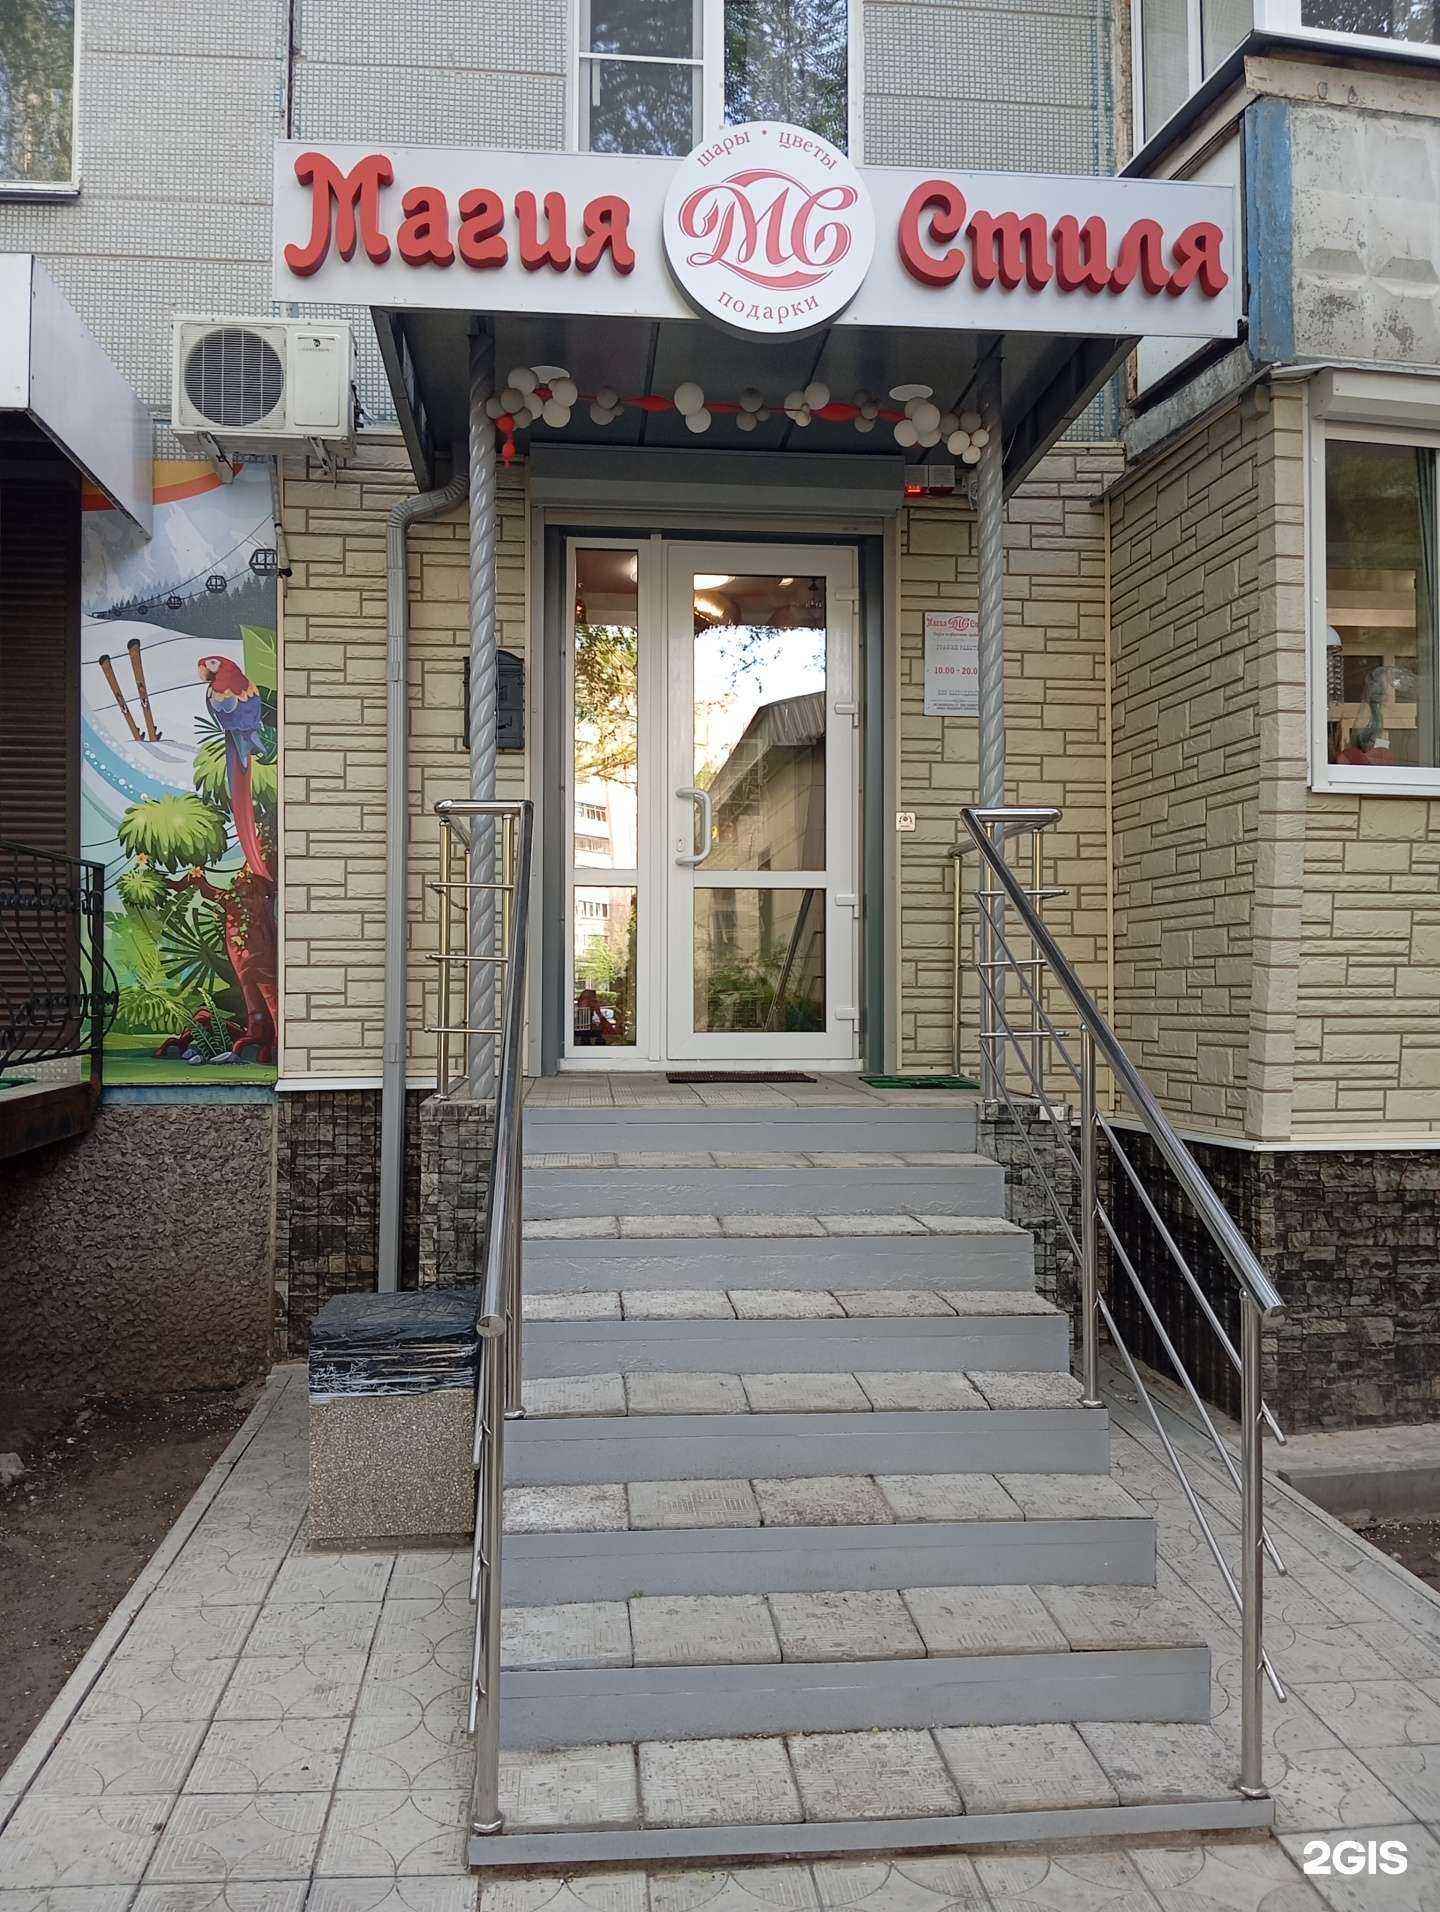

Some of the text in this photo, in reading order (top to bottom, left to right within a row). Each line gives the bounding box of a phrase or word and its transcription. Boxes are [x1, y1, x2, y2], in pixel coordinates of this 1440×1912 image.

[697, 131, 838, 170] шары цветы
[284, 152, 1229, 297] Магия Стиля
[718, 291, 819, 324] подарки
[961, 667, 978, 675] 20.0
